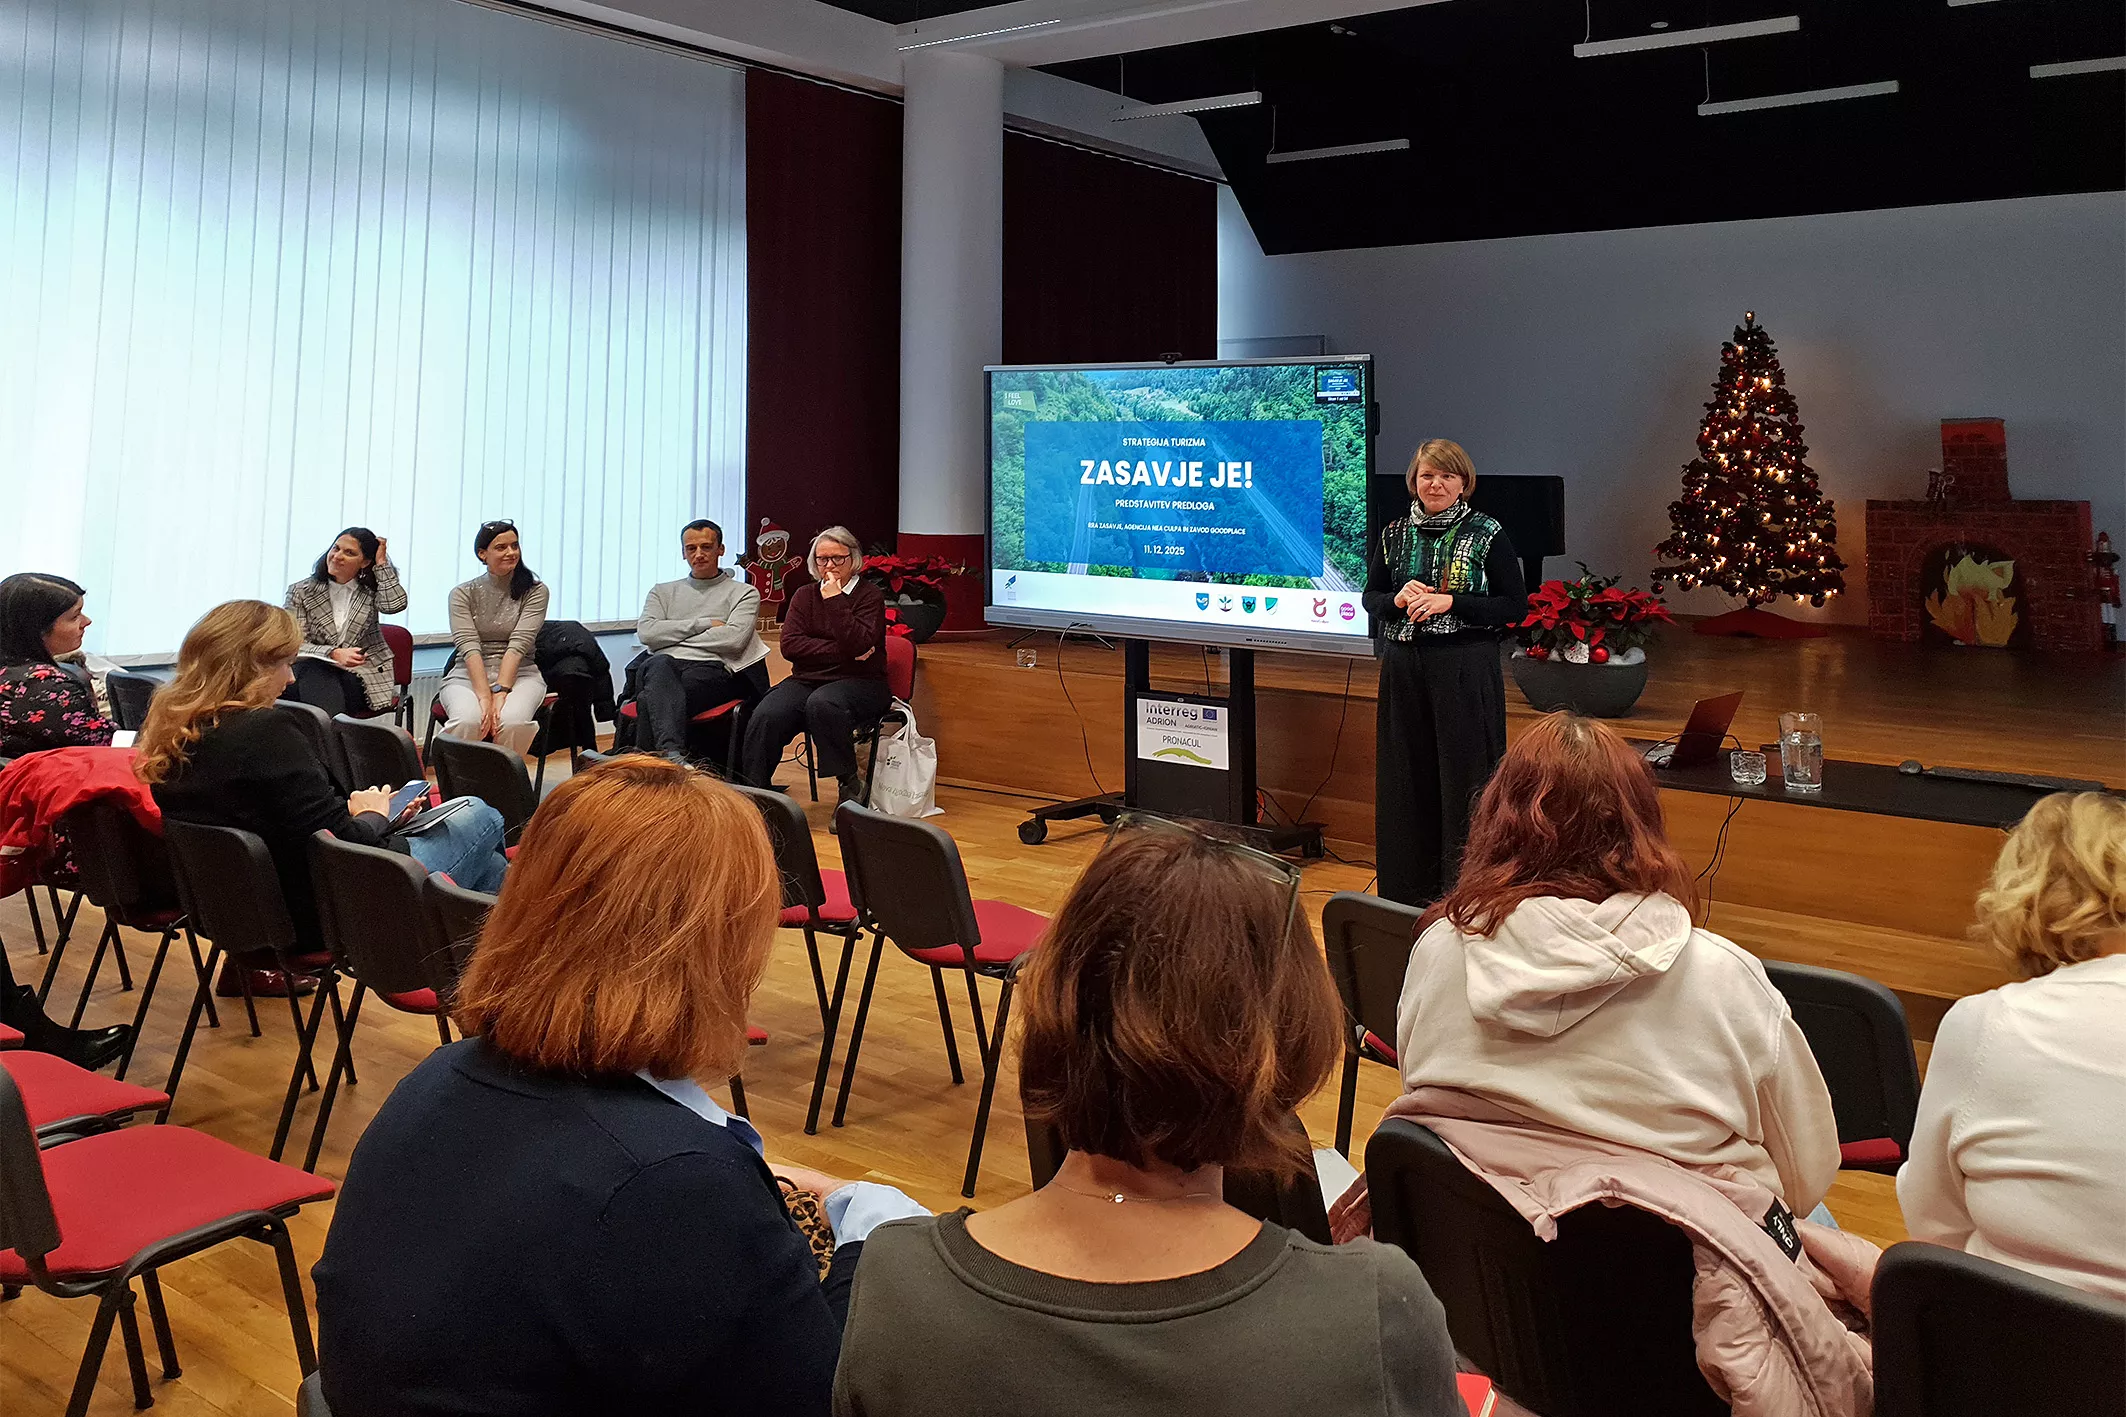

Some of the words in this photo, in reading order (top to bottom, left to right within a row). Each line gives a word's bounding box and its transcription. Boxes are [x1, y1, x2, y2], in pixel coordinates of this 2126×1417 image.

[1122, 437, 1169, 447] STRATEGIJA
[1171, 437, 1206, 447] TURIZMA
[1080, 459, 1204, 488] ZASAVJE
[1209, 460, 1253, 489] JE!
[1115, 499, 1171, 510] PREDSTAVITEV
[1172, 500, 1215, 511] PREDLOGA
[1124, 523, 1151, 531] AGENCIJA
[1210, 527, 1246, 535] GOODPLACE
[1164, 545, 1185, 556] 2025
[1145, 701, 1198, 721] Interreg
[1146, 716, 1177, 727] ADRION
[1162, 735, 1202, 748] PRONACUL
[1772, 1215, 1794, 1249] ONLY
